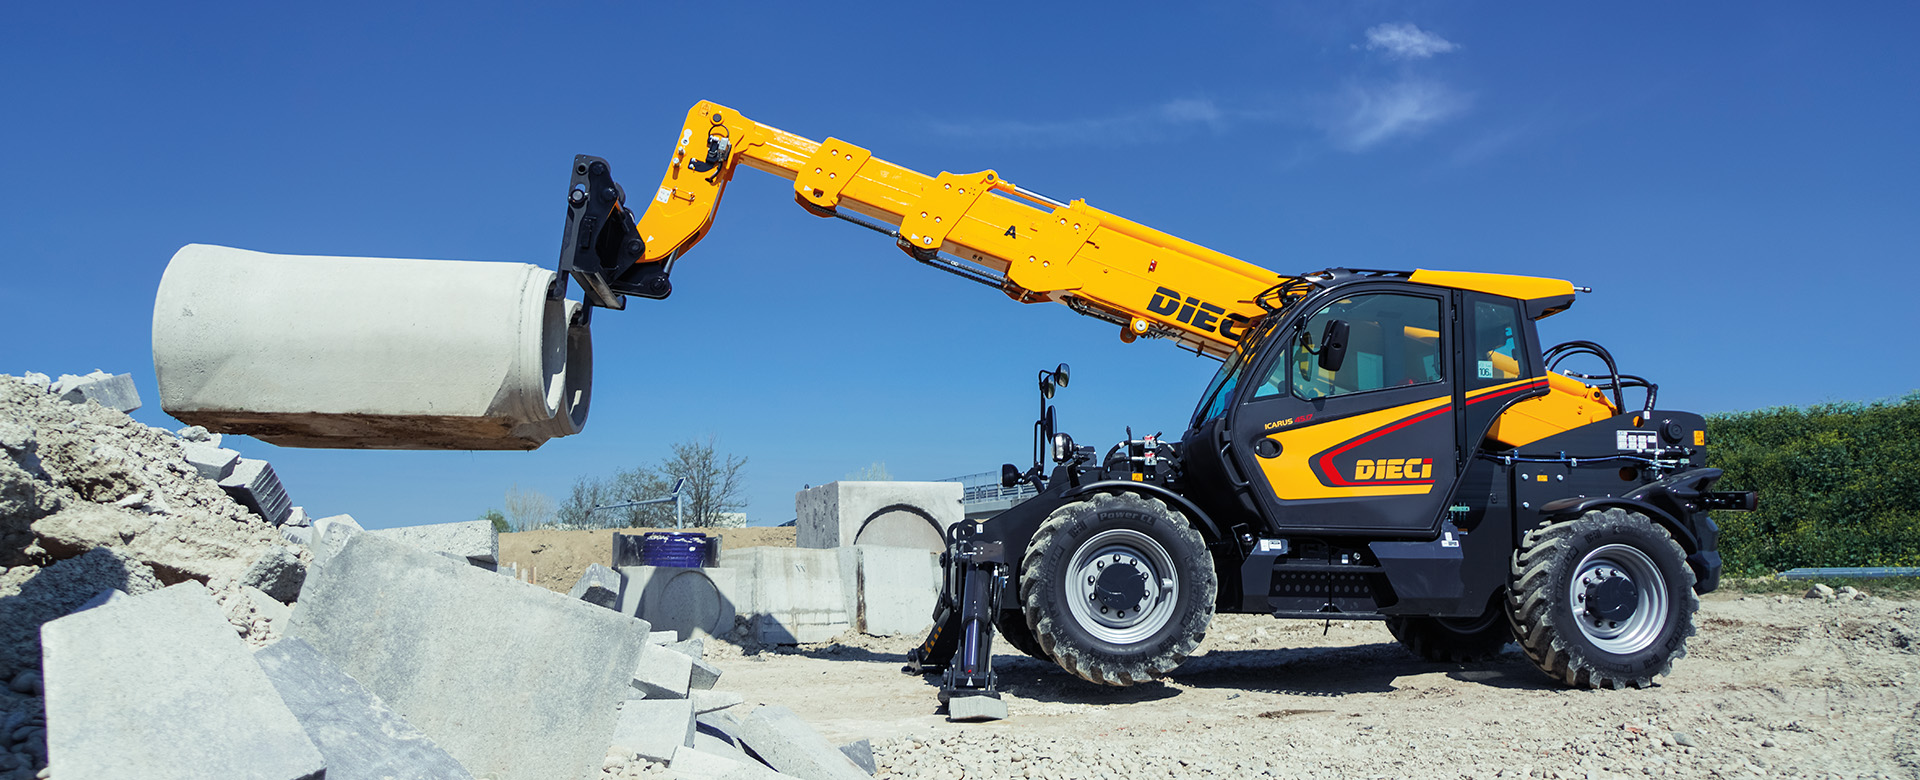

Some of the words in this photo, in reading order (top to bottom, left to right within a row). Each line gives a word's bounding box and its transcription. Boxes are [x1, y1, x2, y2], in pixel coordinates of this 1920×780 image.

[1004, 225, 1016, 239] A
[1146, 286, 1251, 341] DIEC
[1264, 418, 1293, 430] ICARUS
[1100, 511, 1138, 520] Power
[1140, 514, 1154, 525] CL
